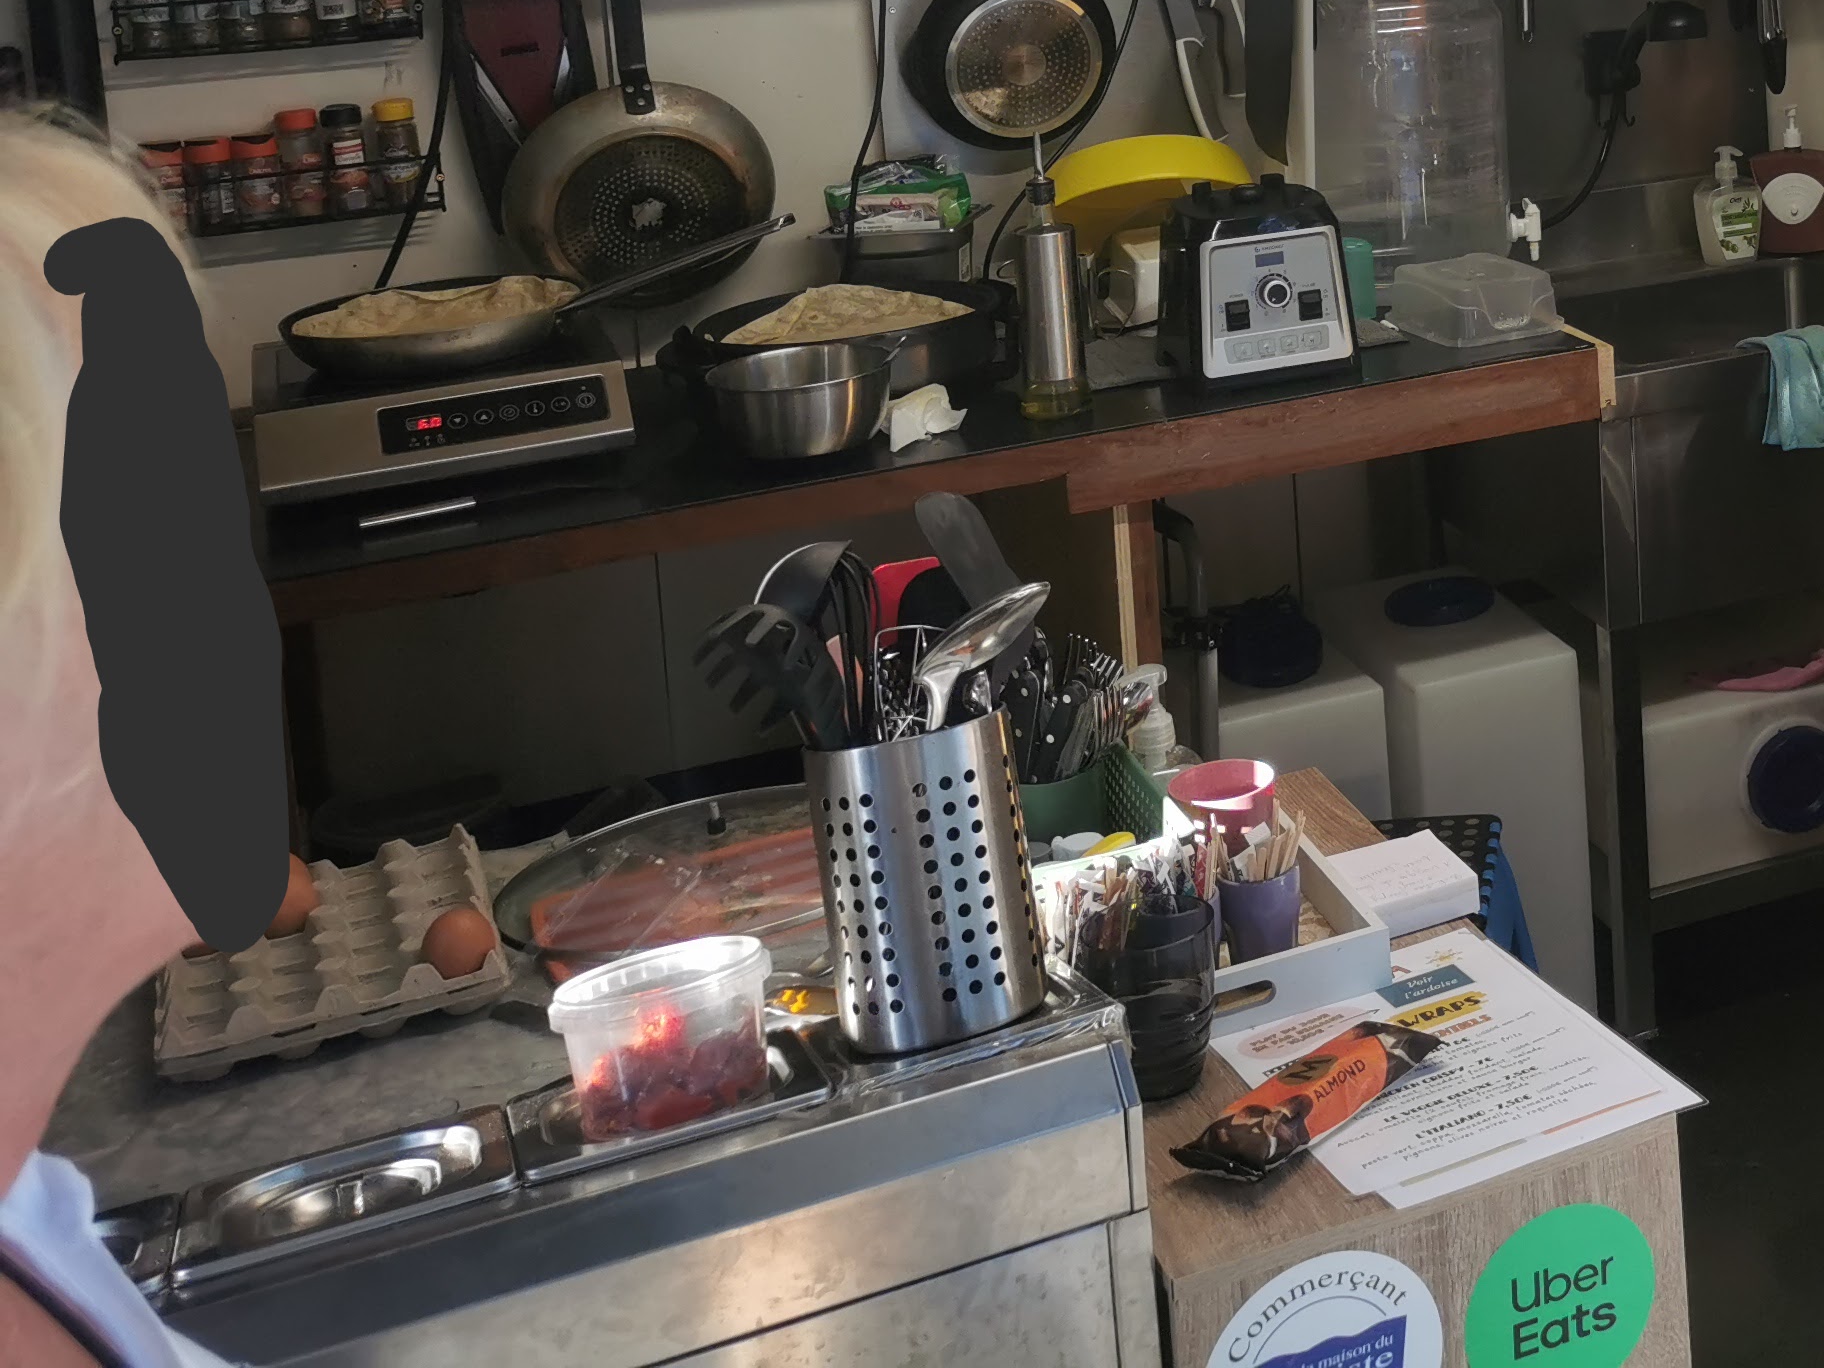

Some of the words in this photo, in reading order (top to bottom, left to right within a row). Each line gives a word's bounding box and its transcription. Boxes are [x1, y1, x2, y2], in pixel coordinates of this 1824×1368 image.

[1396, 995, 1482, 1028] WRAPS
[1313, 1059, 1366, 1102] ALMOND
[1510, 1255, 1615, 1314] Uber
[1228, 1269, 1408, 1364] Commerçant
[1374, 1333, 1395, 1351] du
[1513, 1299, 1618, 1361] Eats
